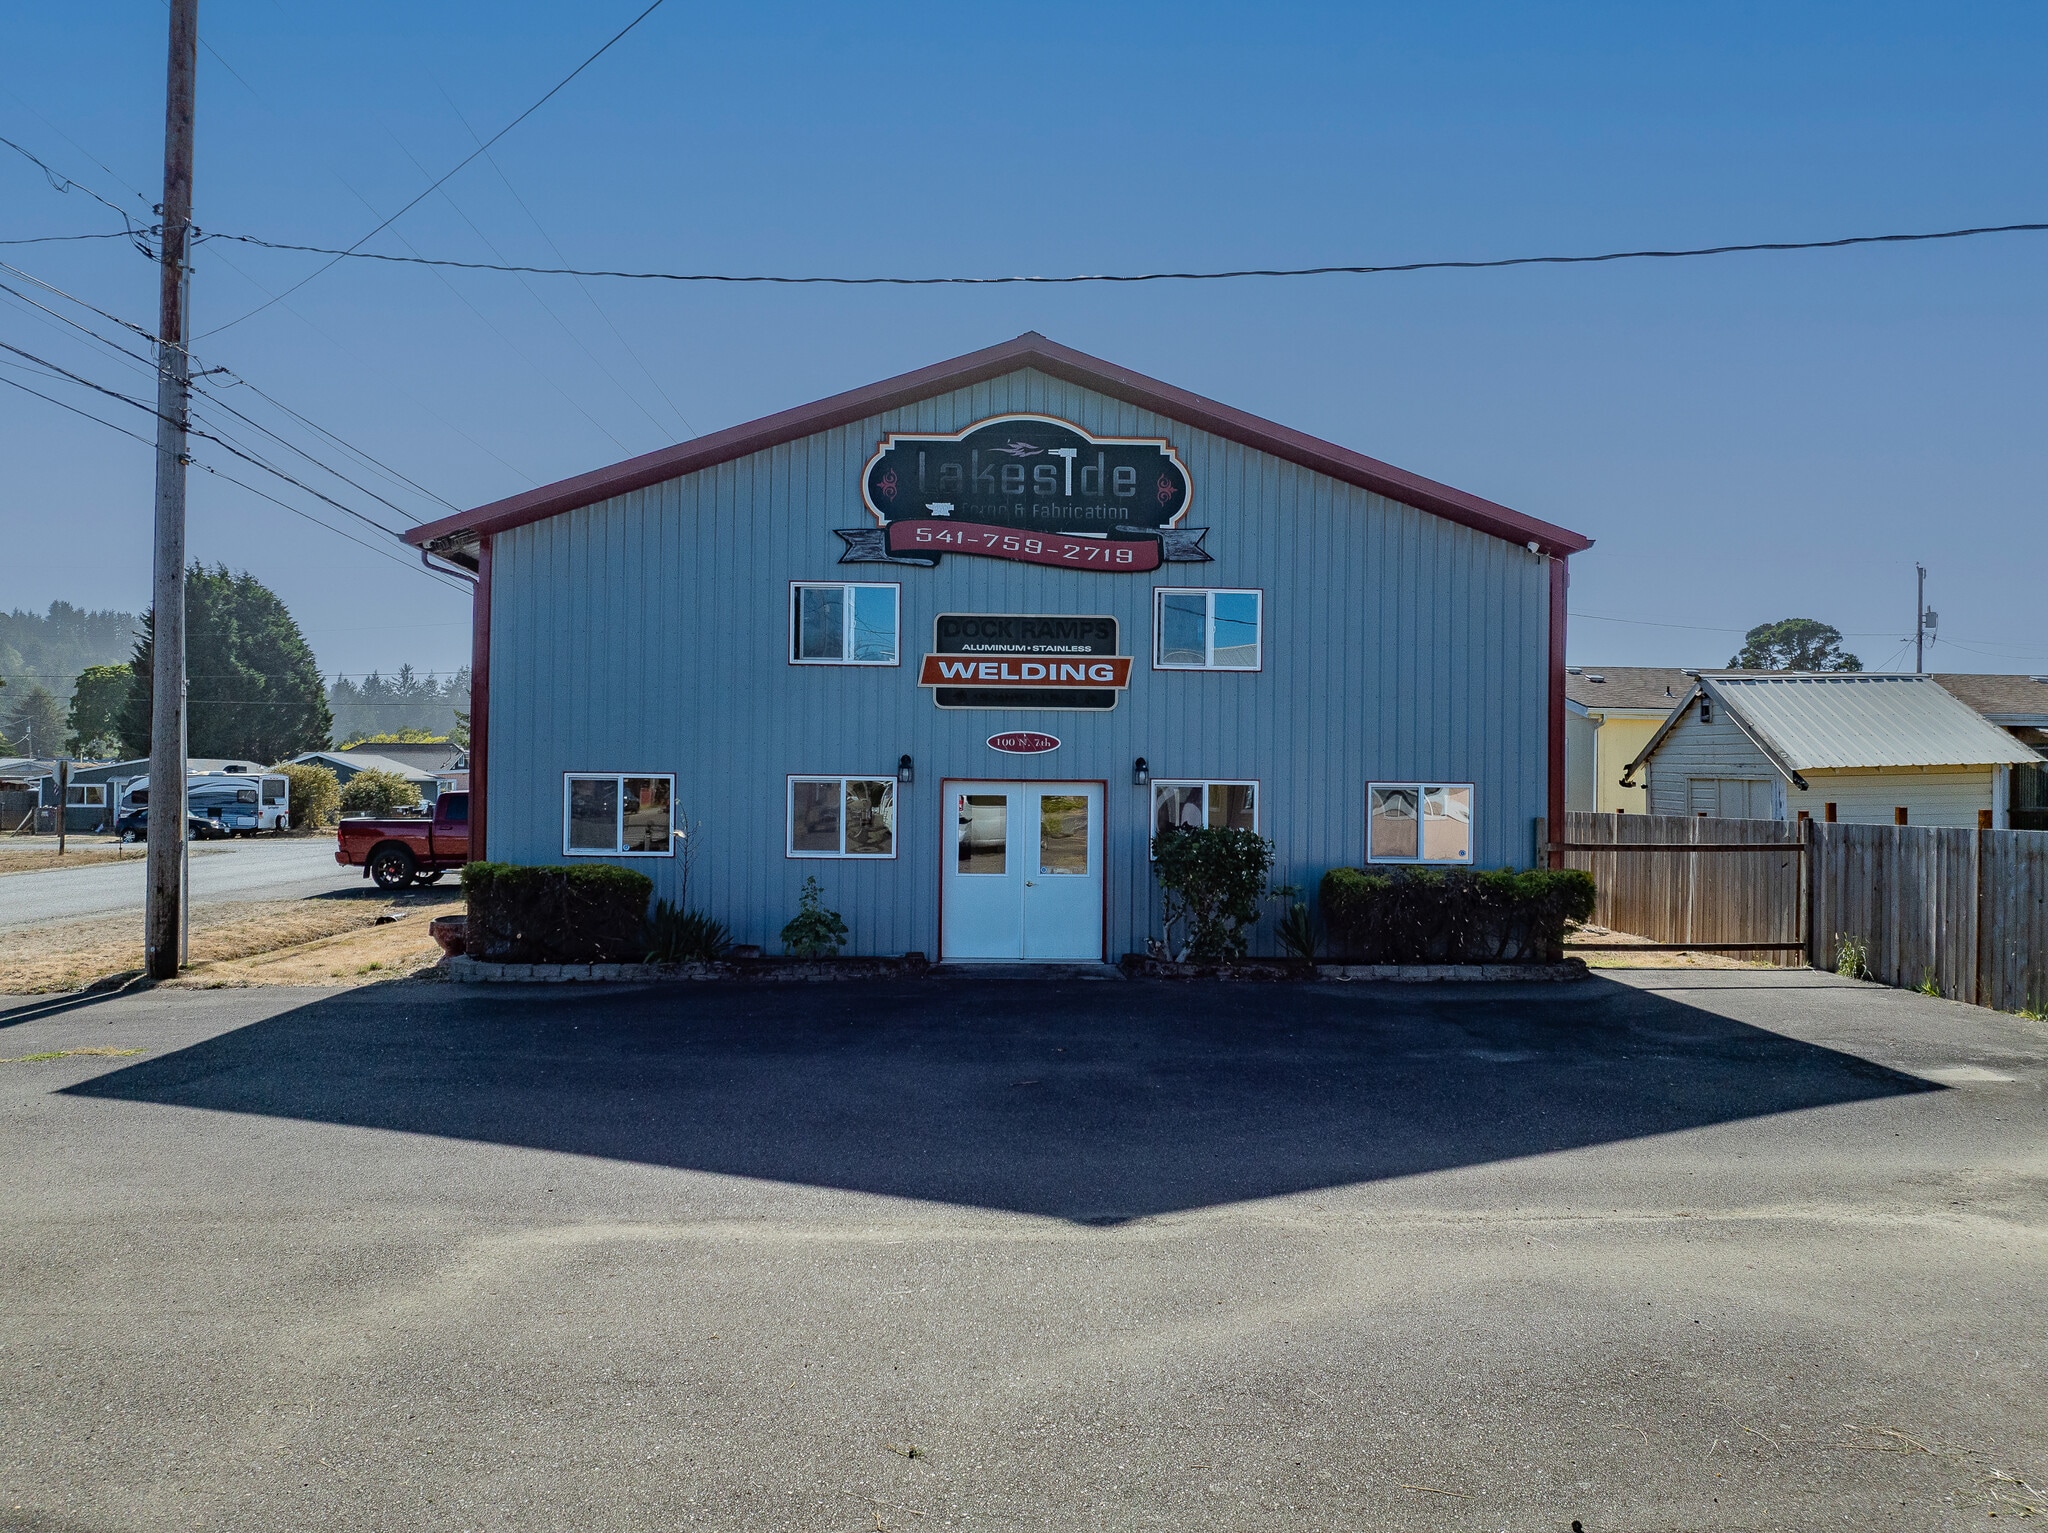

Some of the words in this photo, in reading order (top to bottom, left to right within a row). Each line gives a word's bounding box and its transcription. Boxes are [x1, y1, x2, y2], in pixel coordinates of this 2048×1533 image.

[1033, 502, 1129, 520] Fabrication
[916, 527, 1133, 564] 541-759-2719
[943, 619, 1014, 638] DOCK
[1021, 621, 1110, 640] RAMPS
[938, 661, 1114, 682] WELDING
[996, 738, 1016, 746] 100
